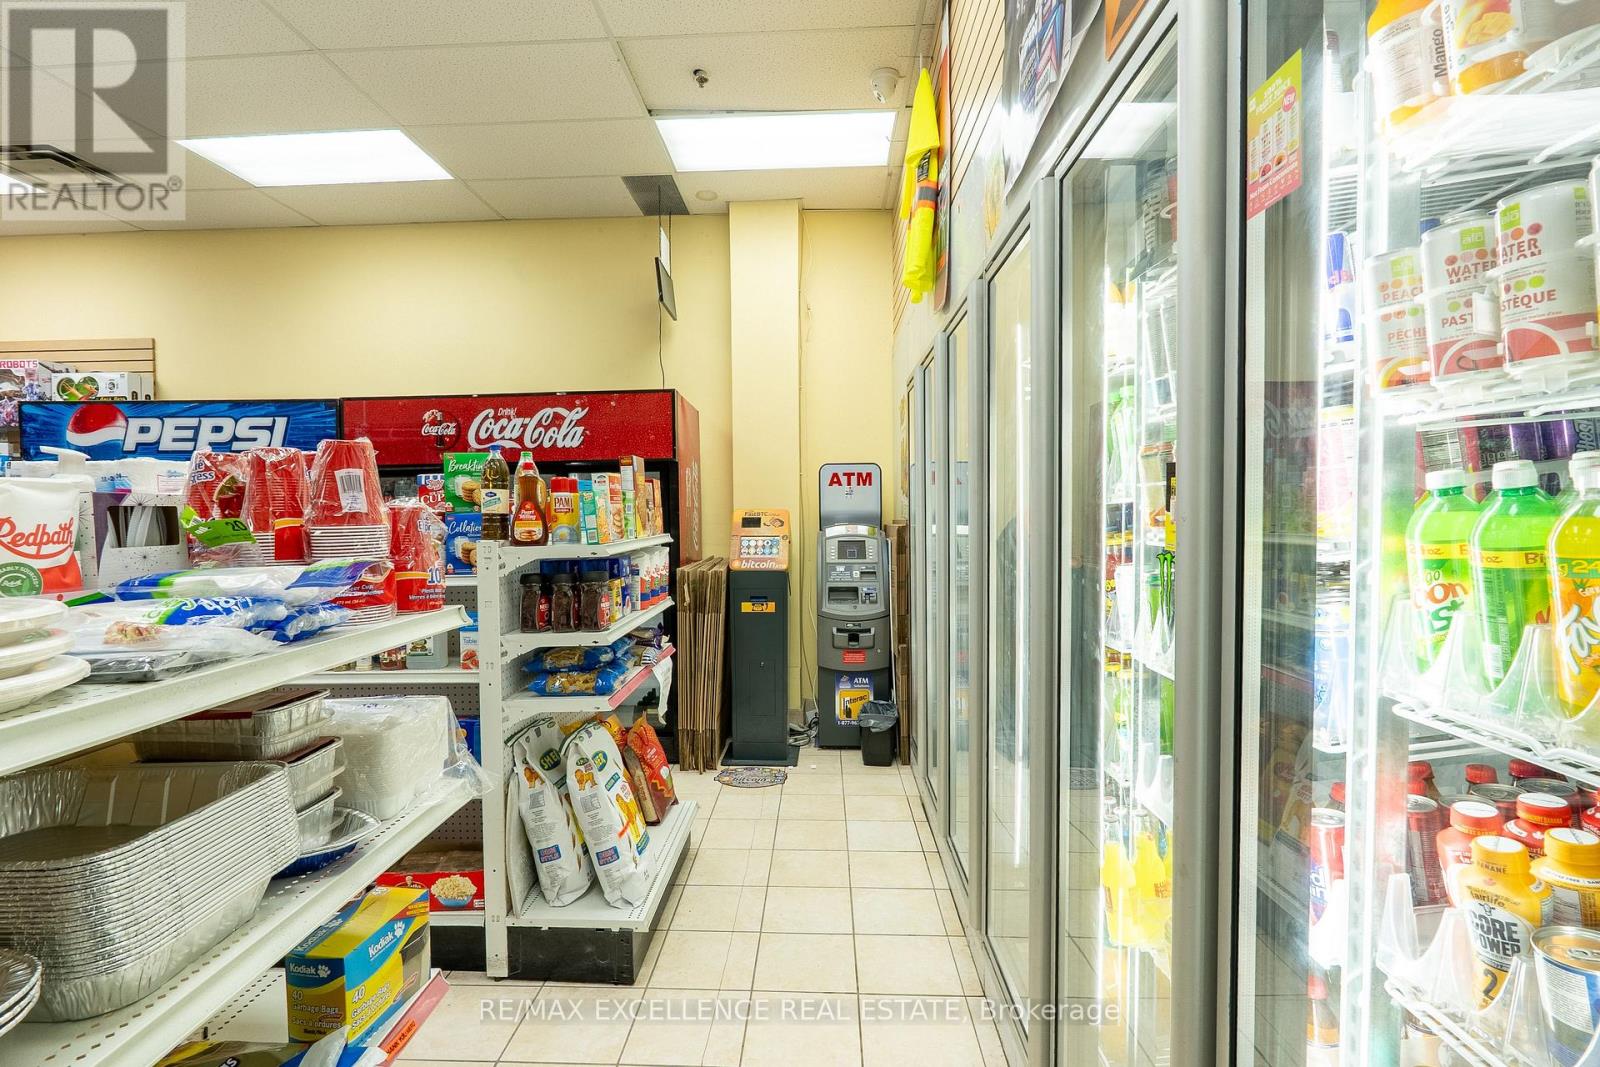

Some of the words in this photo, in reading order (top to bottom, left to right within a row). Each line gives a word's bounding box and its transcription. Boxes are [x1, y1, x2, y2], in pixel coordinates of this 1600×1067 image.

[1433, 29, 1448, 79] Mango
[0, 360, 38, 369] ROBOTS
[122, 416, 289, 452] PEPSI
[421, 422, 457, 436] Coca-Cola
[468, 406, 590, 449] Coca-Cola
[828, 472, 873, 487] ATM
[554, 497, 573, 509] PAM
[225, 519, 248, 532] 20
[741, 559, 776, 569] bitcoin
[843, 694, 868, 707] Interac
[1470, 890, 1506, 908] fairlife
[1471, 910, 1521, 944] CORE
[368, 931, 395, 958] Kodiak
[289, 963, 316, 975] Kodiak
[1482, 967, 1498, 1001] 2
[292, 990, 303, 1001] 40
[352, 984, 366, 1004] 40
